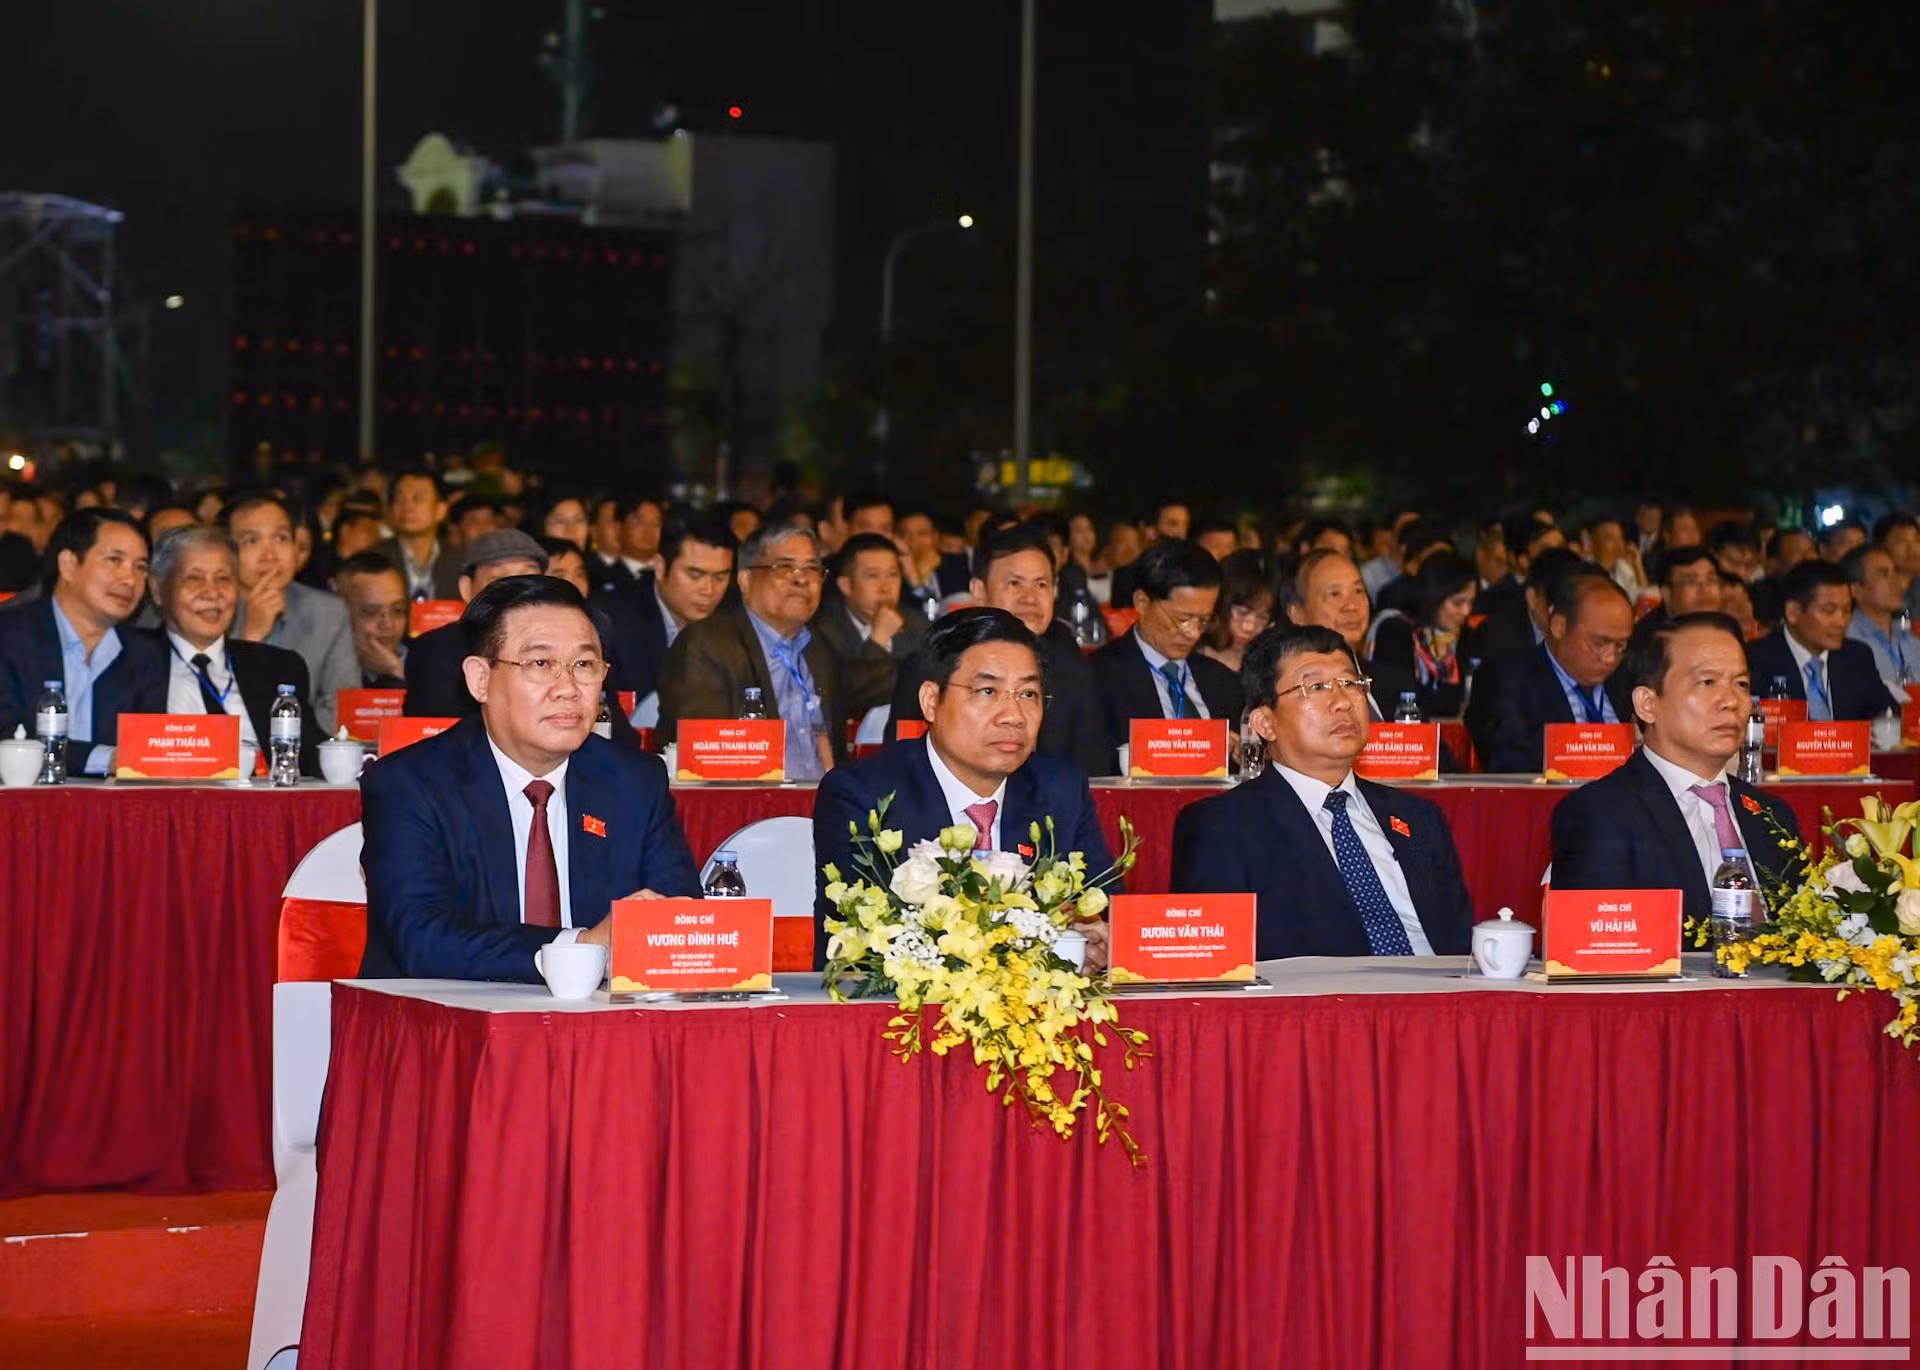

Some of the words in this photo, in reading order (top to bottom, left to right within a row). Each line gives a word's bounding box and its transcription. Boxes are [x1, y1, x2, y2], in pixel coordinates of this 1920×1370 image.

[148, 738, 174, 749] PHẠM
[175, 736, 196, 748] THÁI
[197, 736, 211, 748] HÀ
[693, 740, 720, 751] HOÀNG
[721, 741, 747, 751] THANH
[1405, 743, 1424, 752] KHOA
[1598, 743, 1616, 752] KHOA
[1838, 741, 1853, 749] LINH
[1166, 907, 1187, 918] ĐỒNG
[1188, 907, 1202, 918] CHÍ
[1598, 903, 1618, 913] ĐỒNG
[1619, 902, 1632, 912] CHÍ
[674, 914, 698, 925] ĐỒNG
[699, 914, 714, 925] CHÍ
[1590, 919, 1603, 932] VŨ
[1605, 918, 1622, 932] HẢI
[1624, 919, 1638, 932] HÀ
[1141, 926, 1176, 939] DƯƠNG
[1177, 924, 1199, 938] VĂN
[1200, 923, 1225, 937] THÁI
[647, 933, 686, 946] VƯƠNG
[687, 931, 715, 946] ĐÌNH
[717, 930, 740, 948] HUỆ
